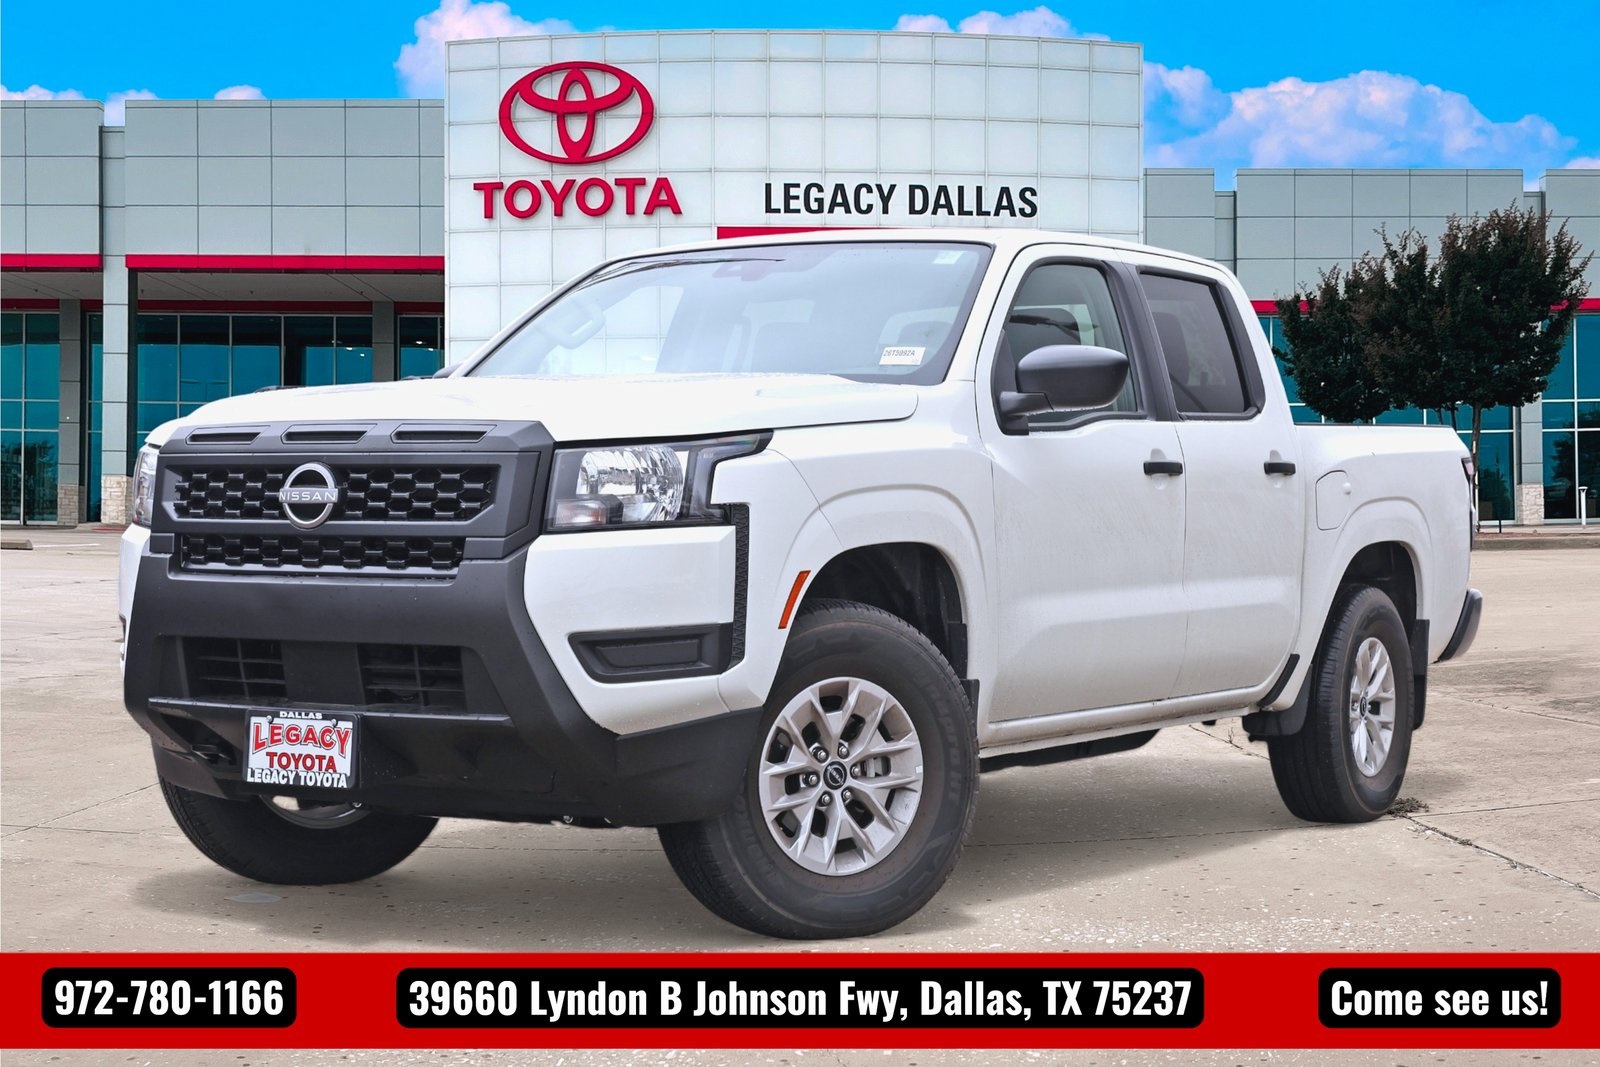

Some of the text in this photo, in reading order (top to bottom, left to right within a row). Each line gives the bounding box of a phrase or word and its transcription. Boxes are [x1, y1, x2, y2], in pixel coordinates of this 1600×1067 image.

[473, 177, 682, 219] TOYOTA
[764, 182, 1038, 218] LEGACY DALLAS
[279, 491, 336, 501] NISSAN
[279, 711, 323, 720] DALLAS
[252, 722, 352, 759] LEGACY
[266, 751, 337, 773] TOYOTA
[246, 768, 348, 788] LEGACY TOYOTA
